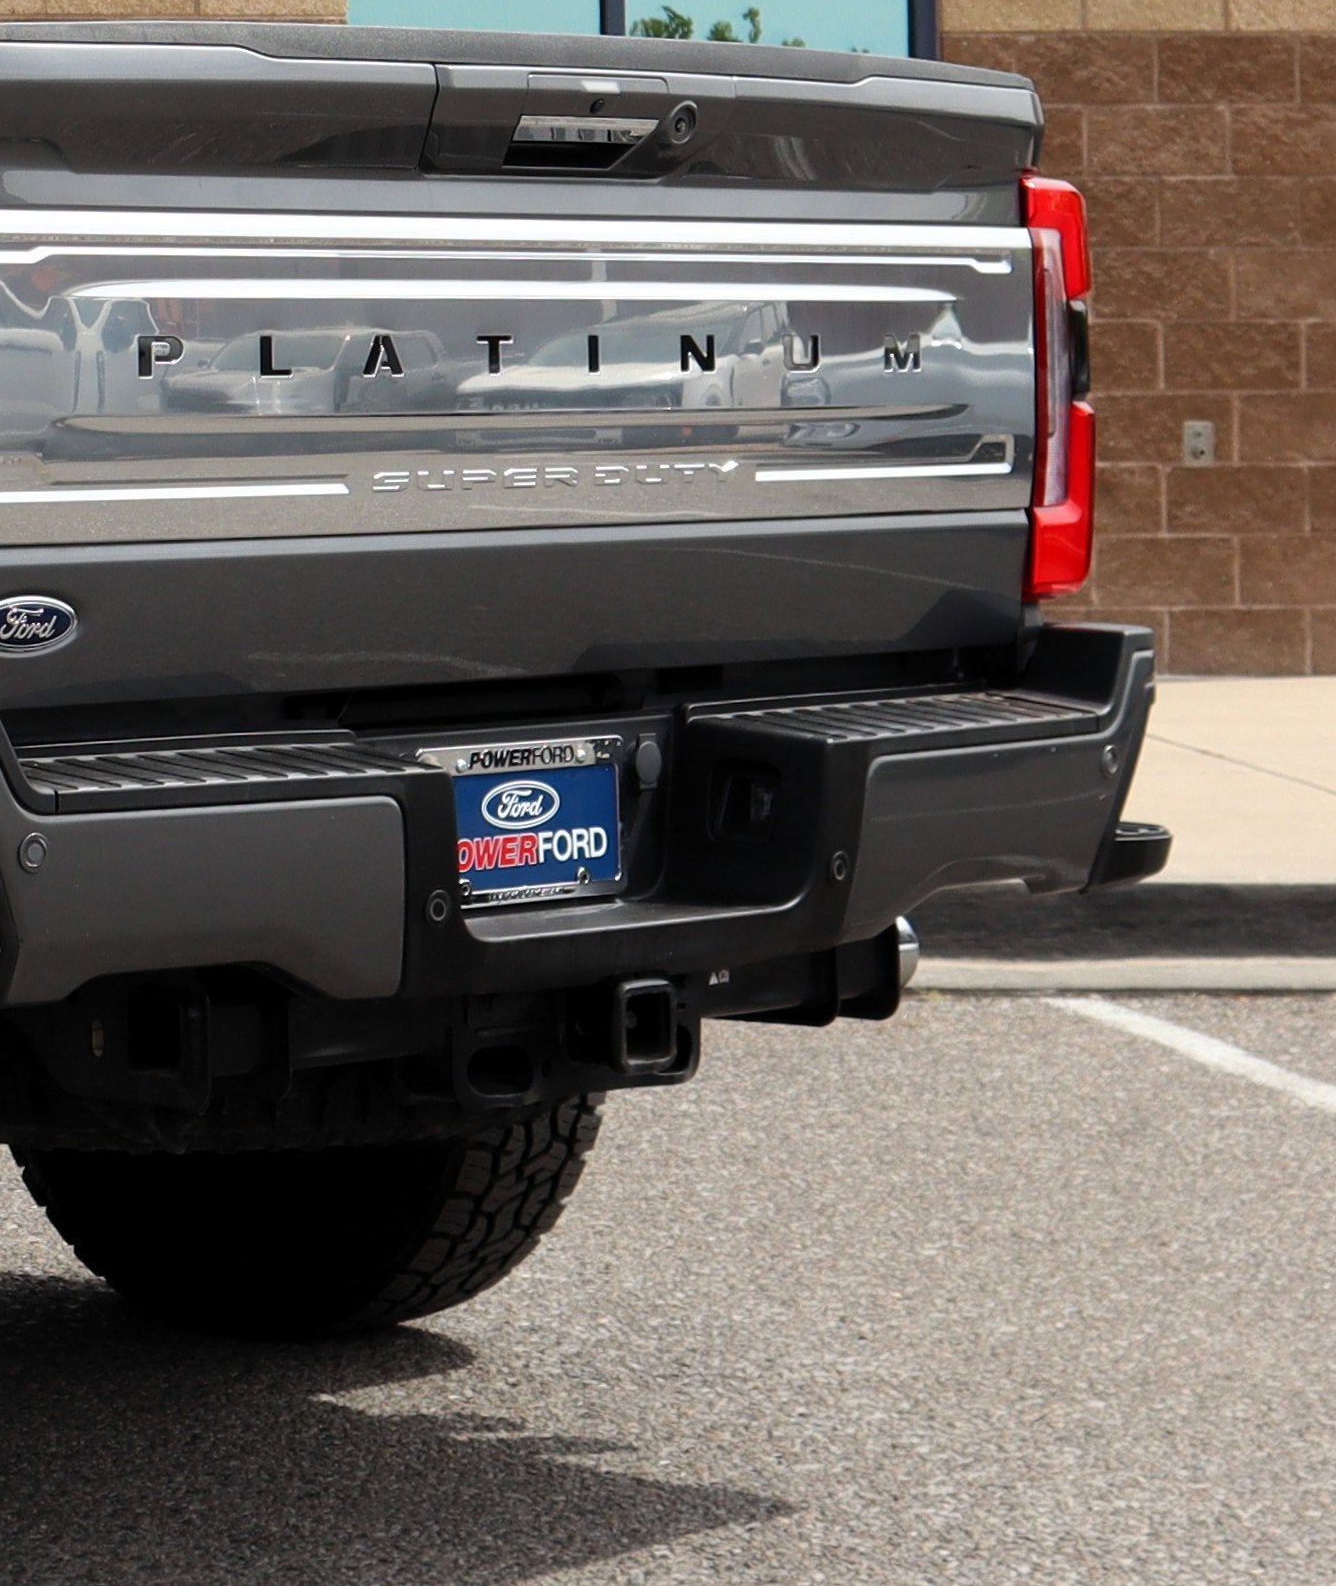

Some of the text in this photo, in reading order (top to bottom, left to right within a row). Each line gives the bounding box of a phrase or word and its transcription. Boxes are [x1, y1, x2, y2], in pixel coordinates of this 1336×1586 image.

[136, 332, 924, 377] PLATINUM
[372, 460, 739, 493] SUPER DUTY
[0, 605, 58, 640] Ford
[468, 744, 575, 771] POWERFORD
[496, 788, 545, 819] Ford
[457, 826, 608, 873] OWERFORD
